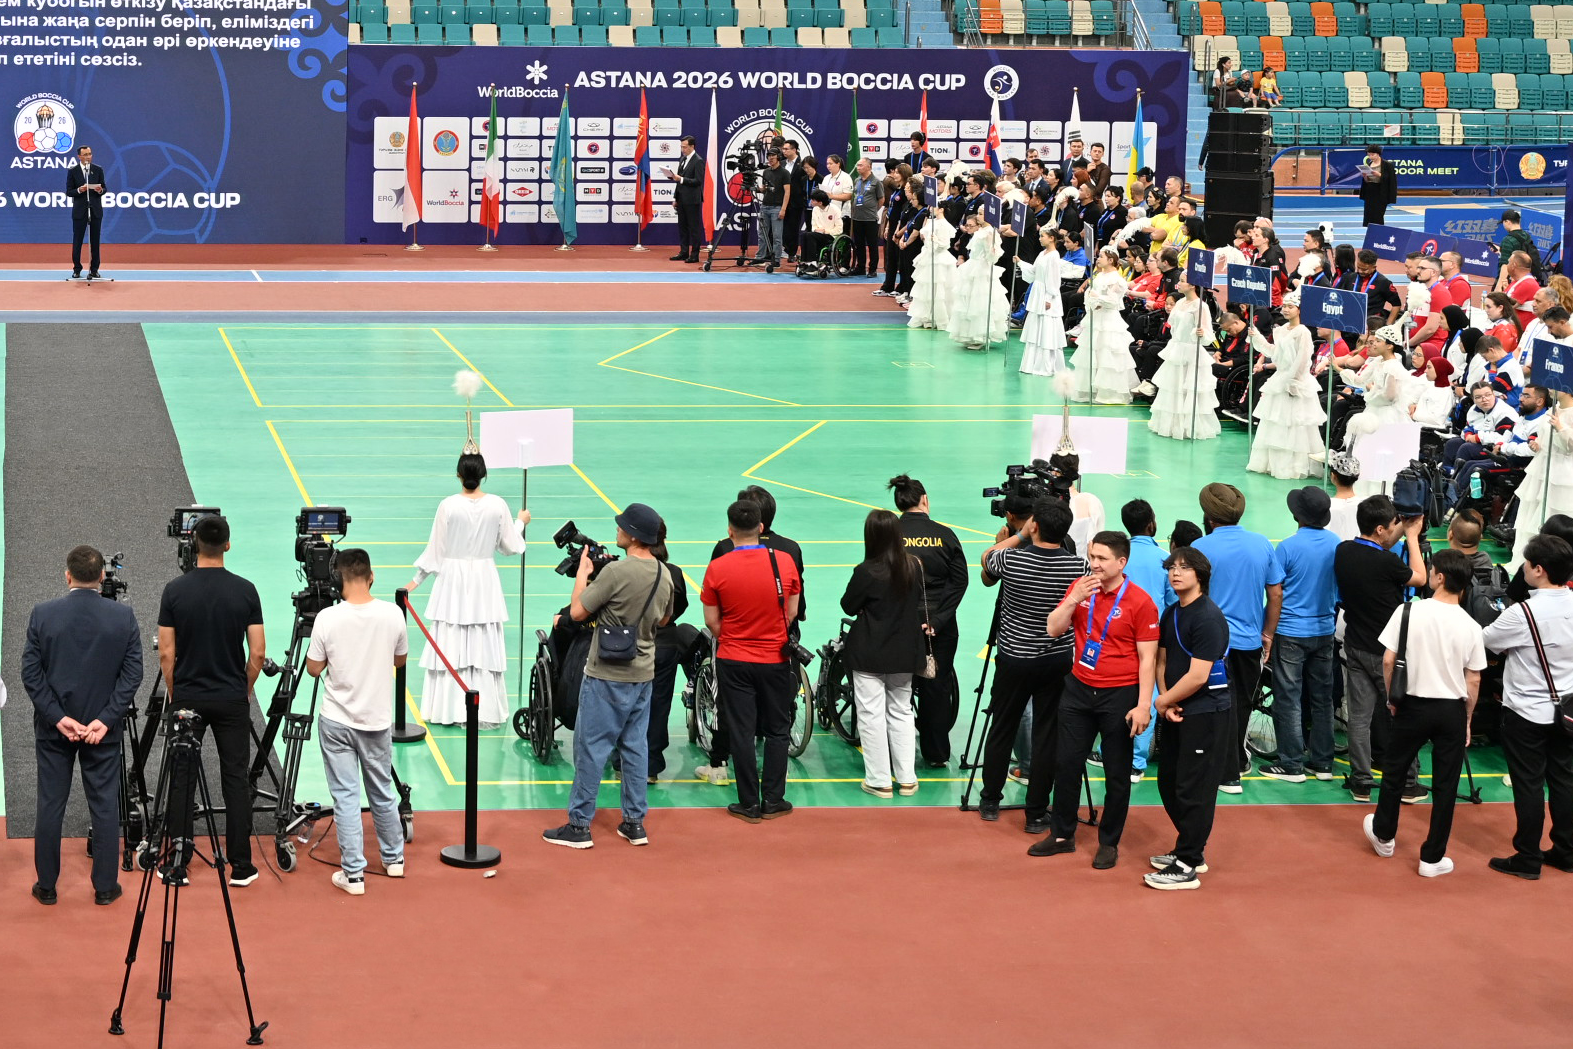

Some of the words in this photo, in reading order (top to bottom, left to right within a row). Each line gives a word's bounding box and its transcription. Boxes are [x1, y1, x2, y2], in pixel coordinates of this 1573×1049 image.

[43, 15, 90, 30] жаңа
[94, 15, 156, 31] серпін
[161, 14, 217, 31] беріп,
[221, 15, 315, 31] еліміздегі
[102, 34, 148, 49] одан
[153, 33, 181, 50] әрі
[185, 34, 301, 51] өркендеуіне
[13, 52, 76, 67] ететіні
[80, 52, 143, 67] сөзсіз.
[573, 70, 668, 88] ASTANA
[672, 71, 734, 88] 2026
[738, 71, 822, 89] WORLD
[827, 72, 915, 90] BOCCIA
[918, 73, 966, 90] CUP
[477, 86, 559, 98] WorldBoccia
[15, 94, 38, 109] WORLD
[38, 92, 63, 102] BOCCIA
[62, 98, 75, 110] CUP
[725, 110, 758, 134] WORLD
[795, 118, 814, 135] CUP
[10, 156, 78, 169] ASTANA
[1427, 167, 1459, 175] MEET
[11, 191, 75, 208] WORL
[101, 192, 189, 209] BOCCIA
[193, 192, 241, 209] CUP
[1231, 277, 1246, 289] Czech
[1246, 279, 1267, 292] Republic
[1322, 302, 1344, 316] Egypt
[1544, 357, 1564, 374] France
[903, 537, 943, 547] ONGOLIA
